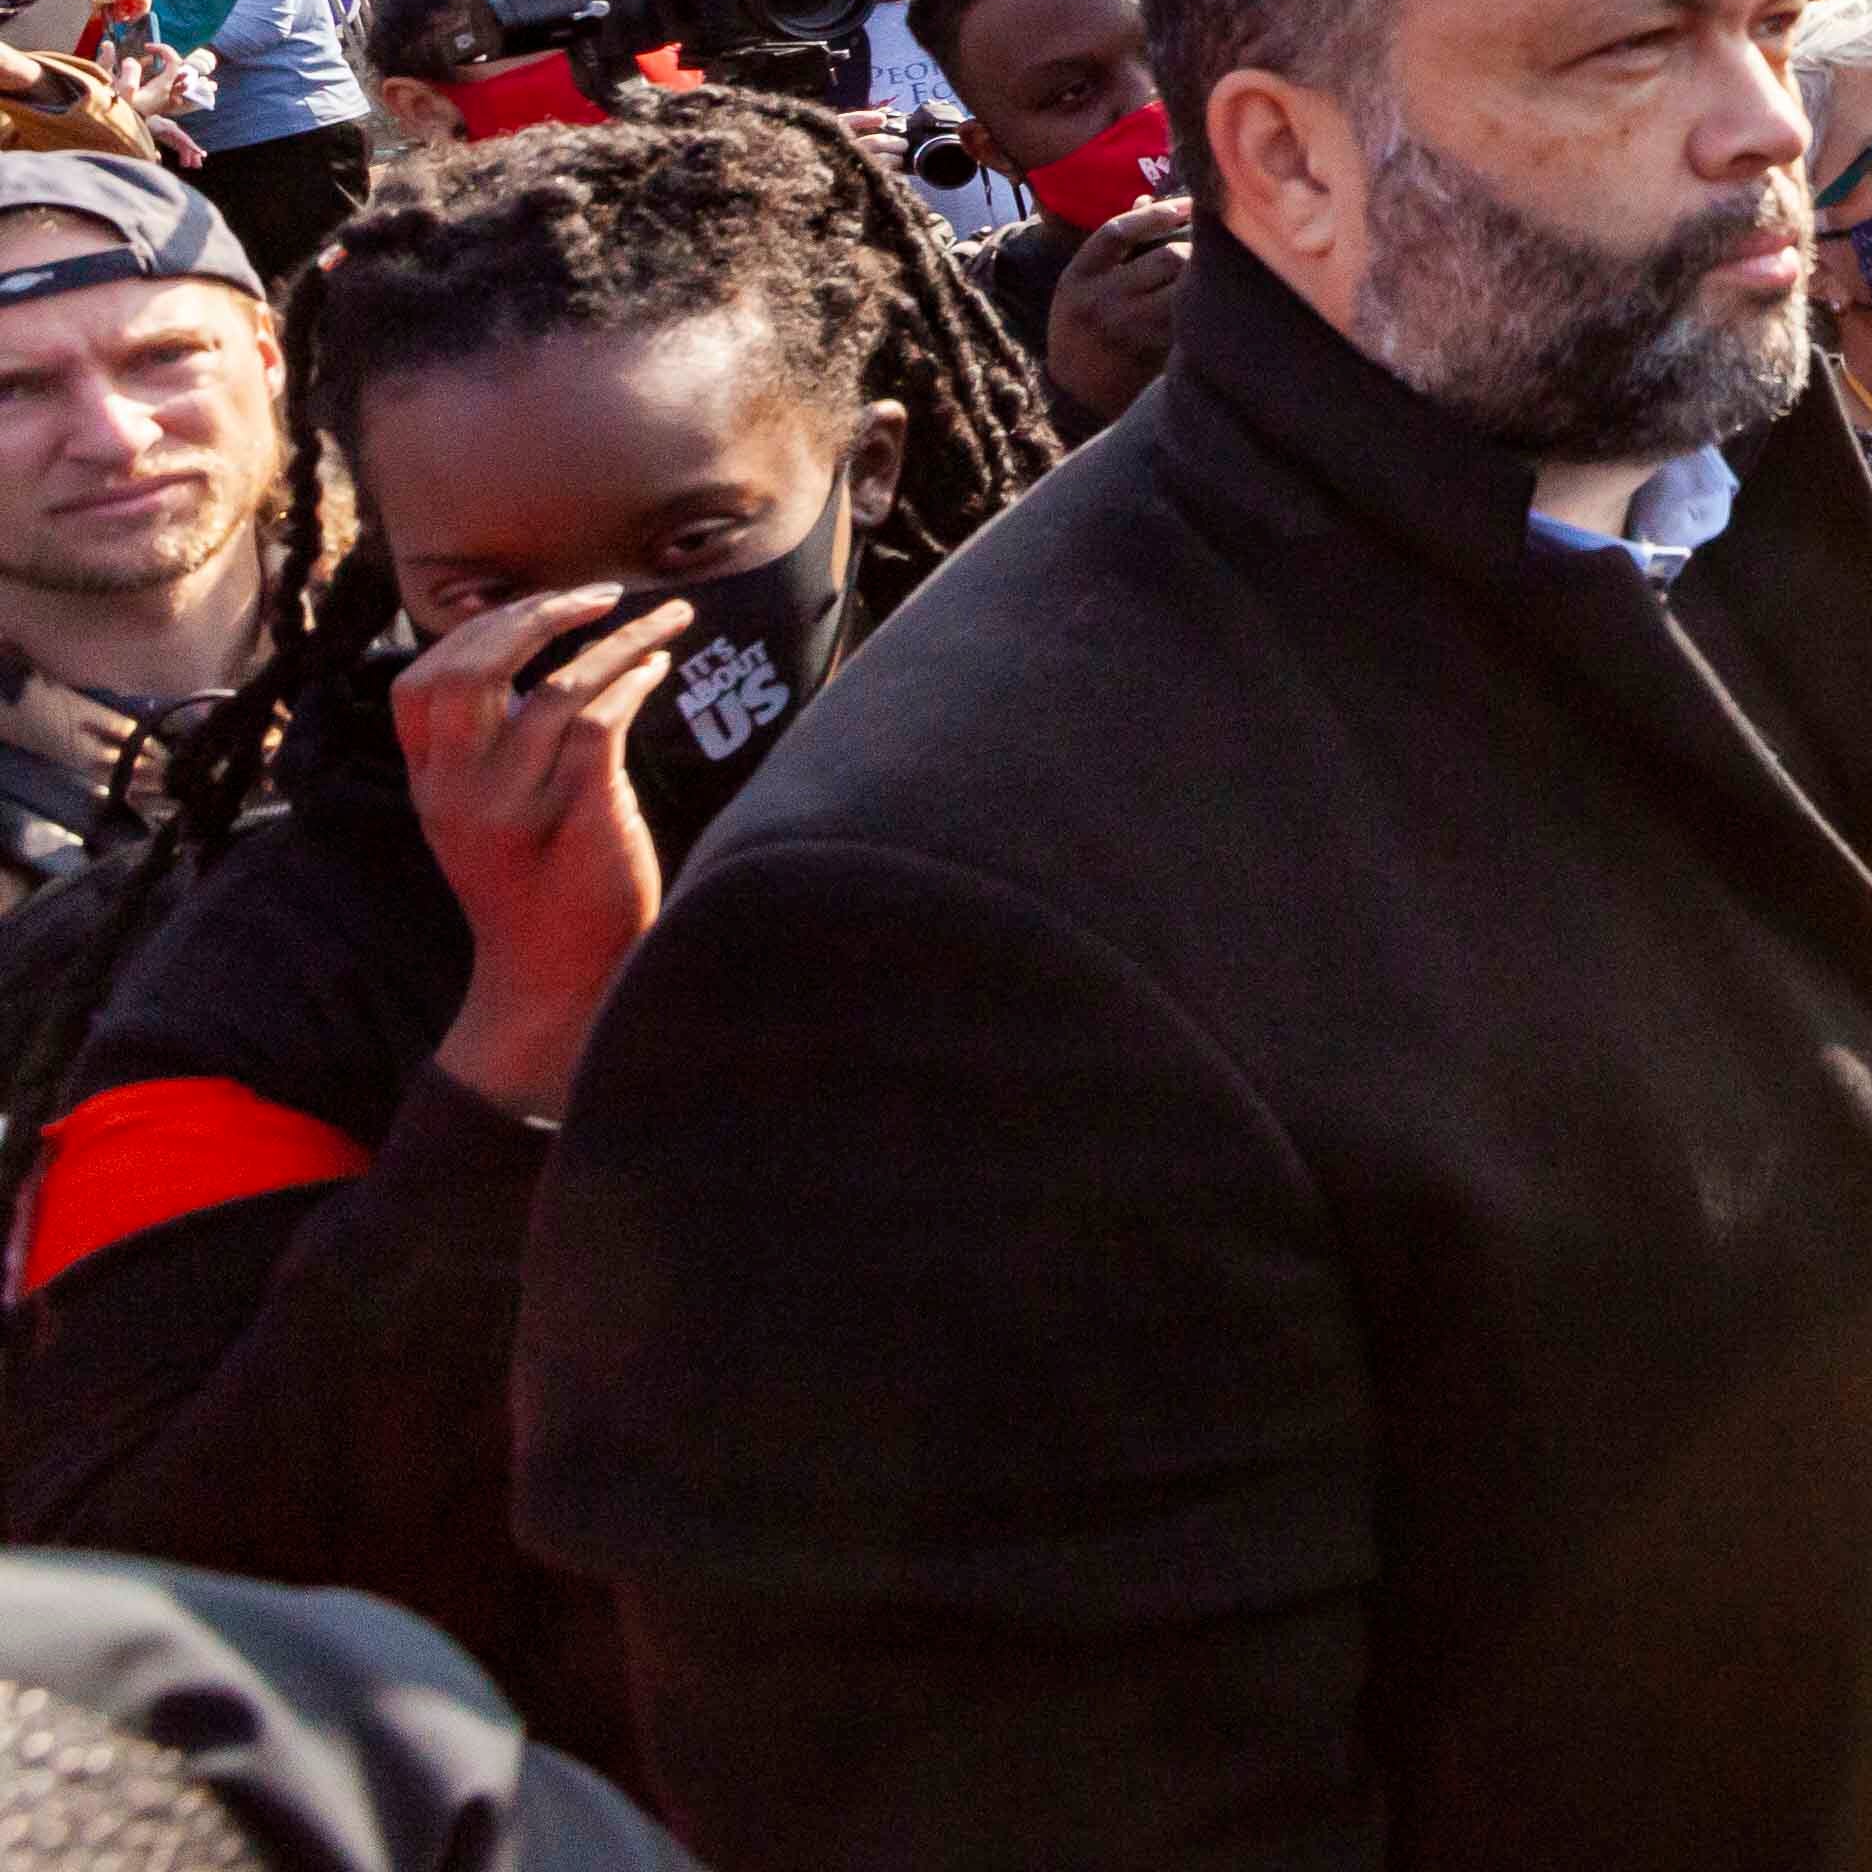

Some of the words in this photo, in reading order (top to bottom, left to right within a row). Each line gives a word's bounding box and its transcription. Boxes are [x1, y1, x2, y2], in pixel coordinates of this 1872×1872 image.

[677, 641, 768, 720] ABOUT
[679, 637, 736, 685] IT'S
[689, 680, 790, 760] US
